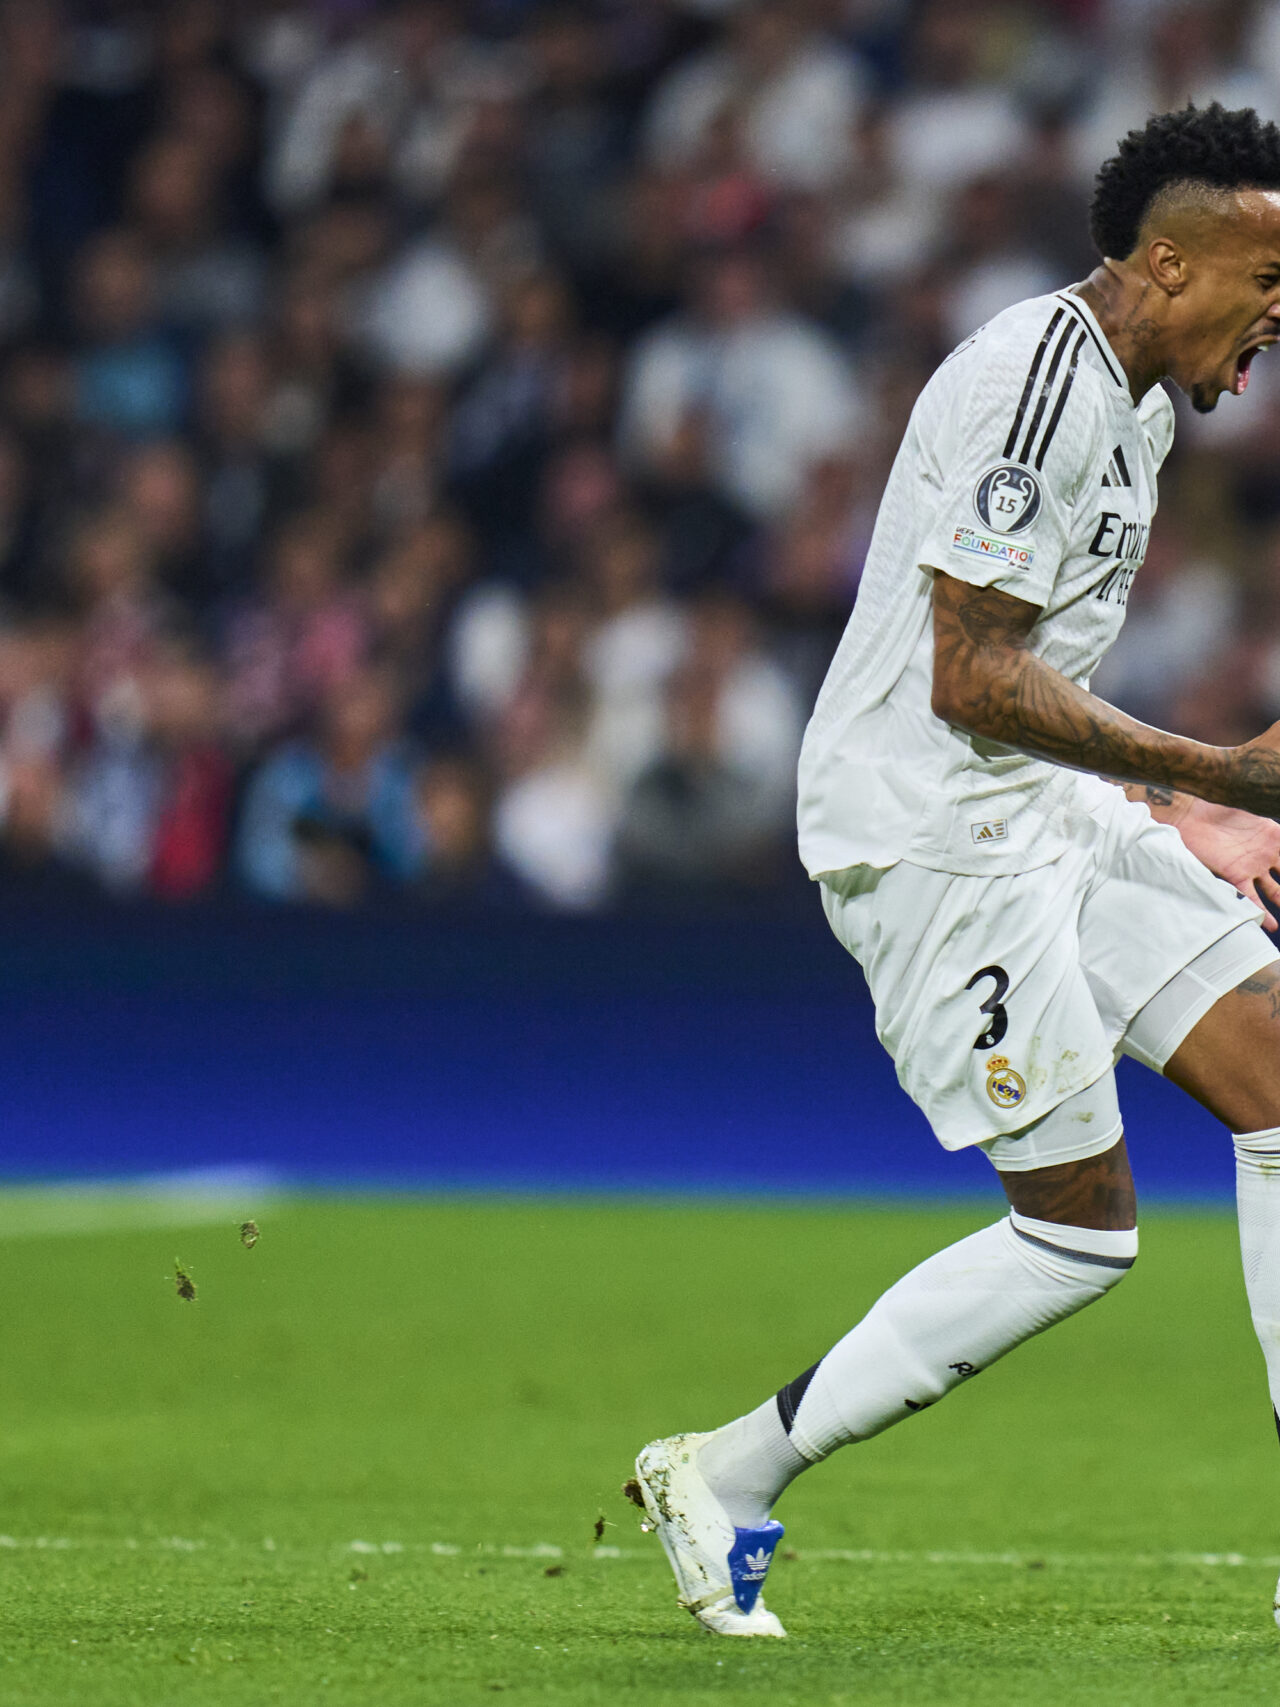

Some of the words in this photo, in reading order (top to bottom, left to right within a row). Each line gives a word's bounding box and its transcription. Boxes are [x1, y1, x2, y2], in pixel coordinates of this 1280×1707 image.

[996, 495, 1017, 514] 15
[956, 526, 975, 537] UEFA
[953, 533, 1035, 564] FOUNDATION
[965, 965, 1010, 1050] 3
